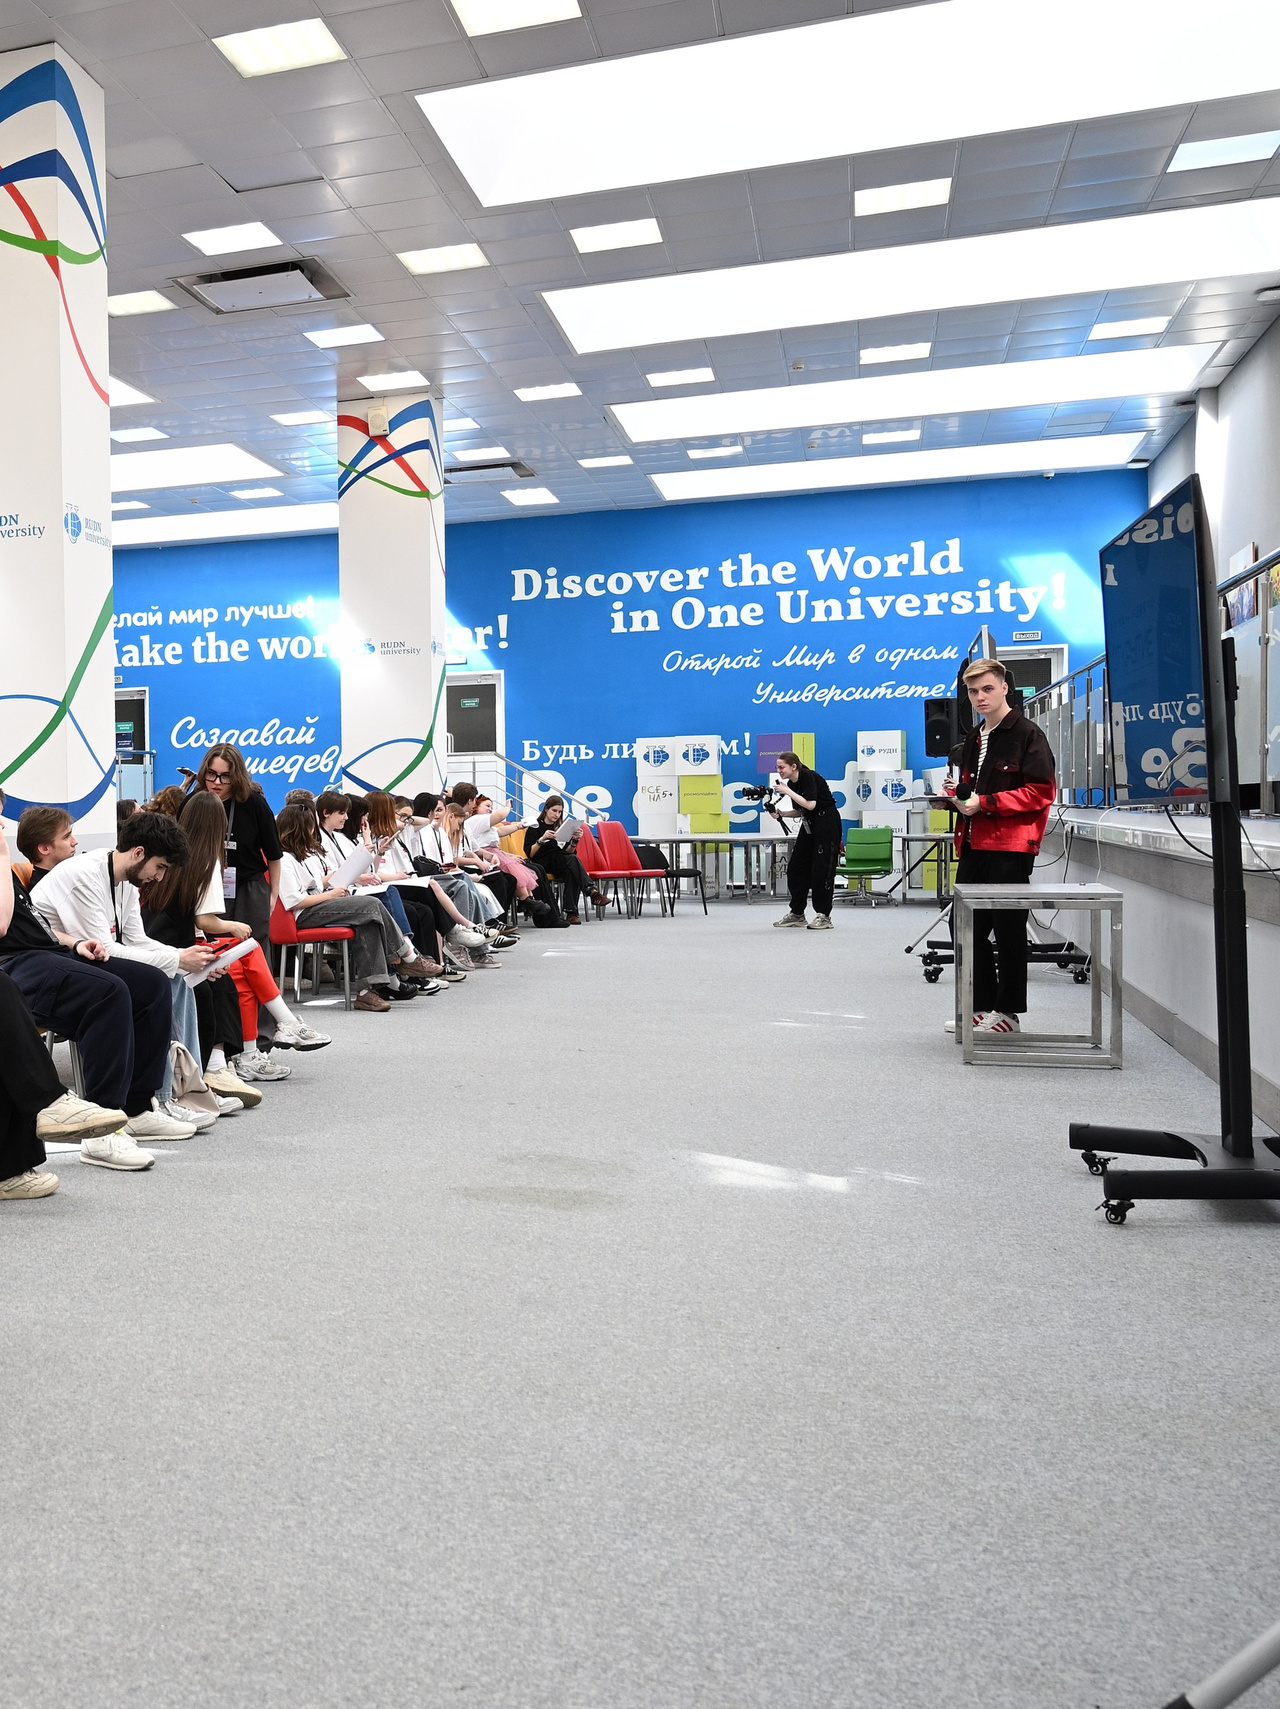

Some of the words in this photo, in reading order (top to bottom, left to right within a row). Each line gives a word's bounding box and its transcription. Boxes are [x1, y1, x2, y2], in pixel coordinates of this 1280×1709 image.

[511, 566, 710, 602] Discover
[718, 552, 798, 588] the
[806, 537, 964, 583] World
[168, 607, 219, 628] мир
[224, 594, 314, 628] лучше!
[610, 600, 661, 634] in
[671, 596, 765, 630] One
[775, 571, 1067, 624] University!
[113, 634, 183, 668] ake
[191, 631, 250, 664] the
[380, 640, 407, 649] RUDN
[380, 646, 421, 656] university
[662, 648, 763, 677] Открой
[771, 644, 836, 671] Мир
[847, 643, 866, 664] в
[874, 644, 959, 671] одном
[752, 680, 959, 707] Университете!
[170, 716, 320, 748] Создавай
[521, 739, 595, 767] Будь
[641, 786, 662, 794] ВСЕ
[662, 790, 674, 799] 5+
